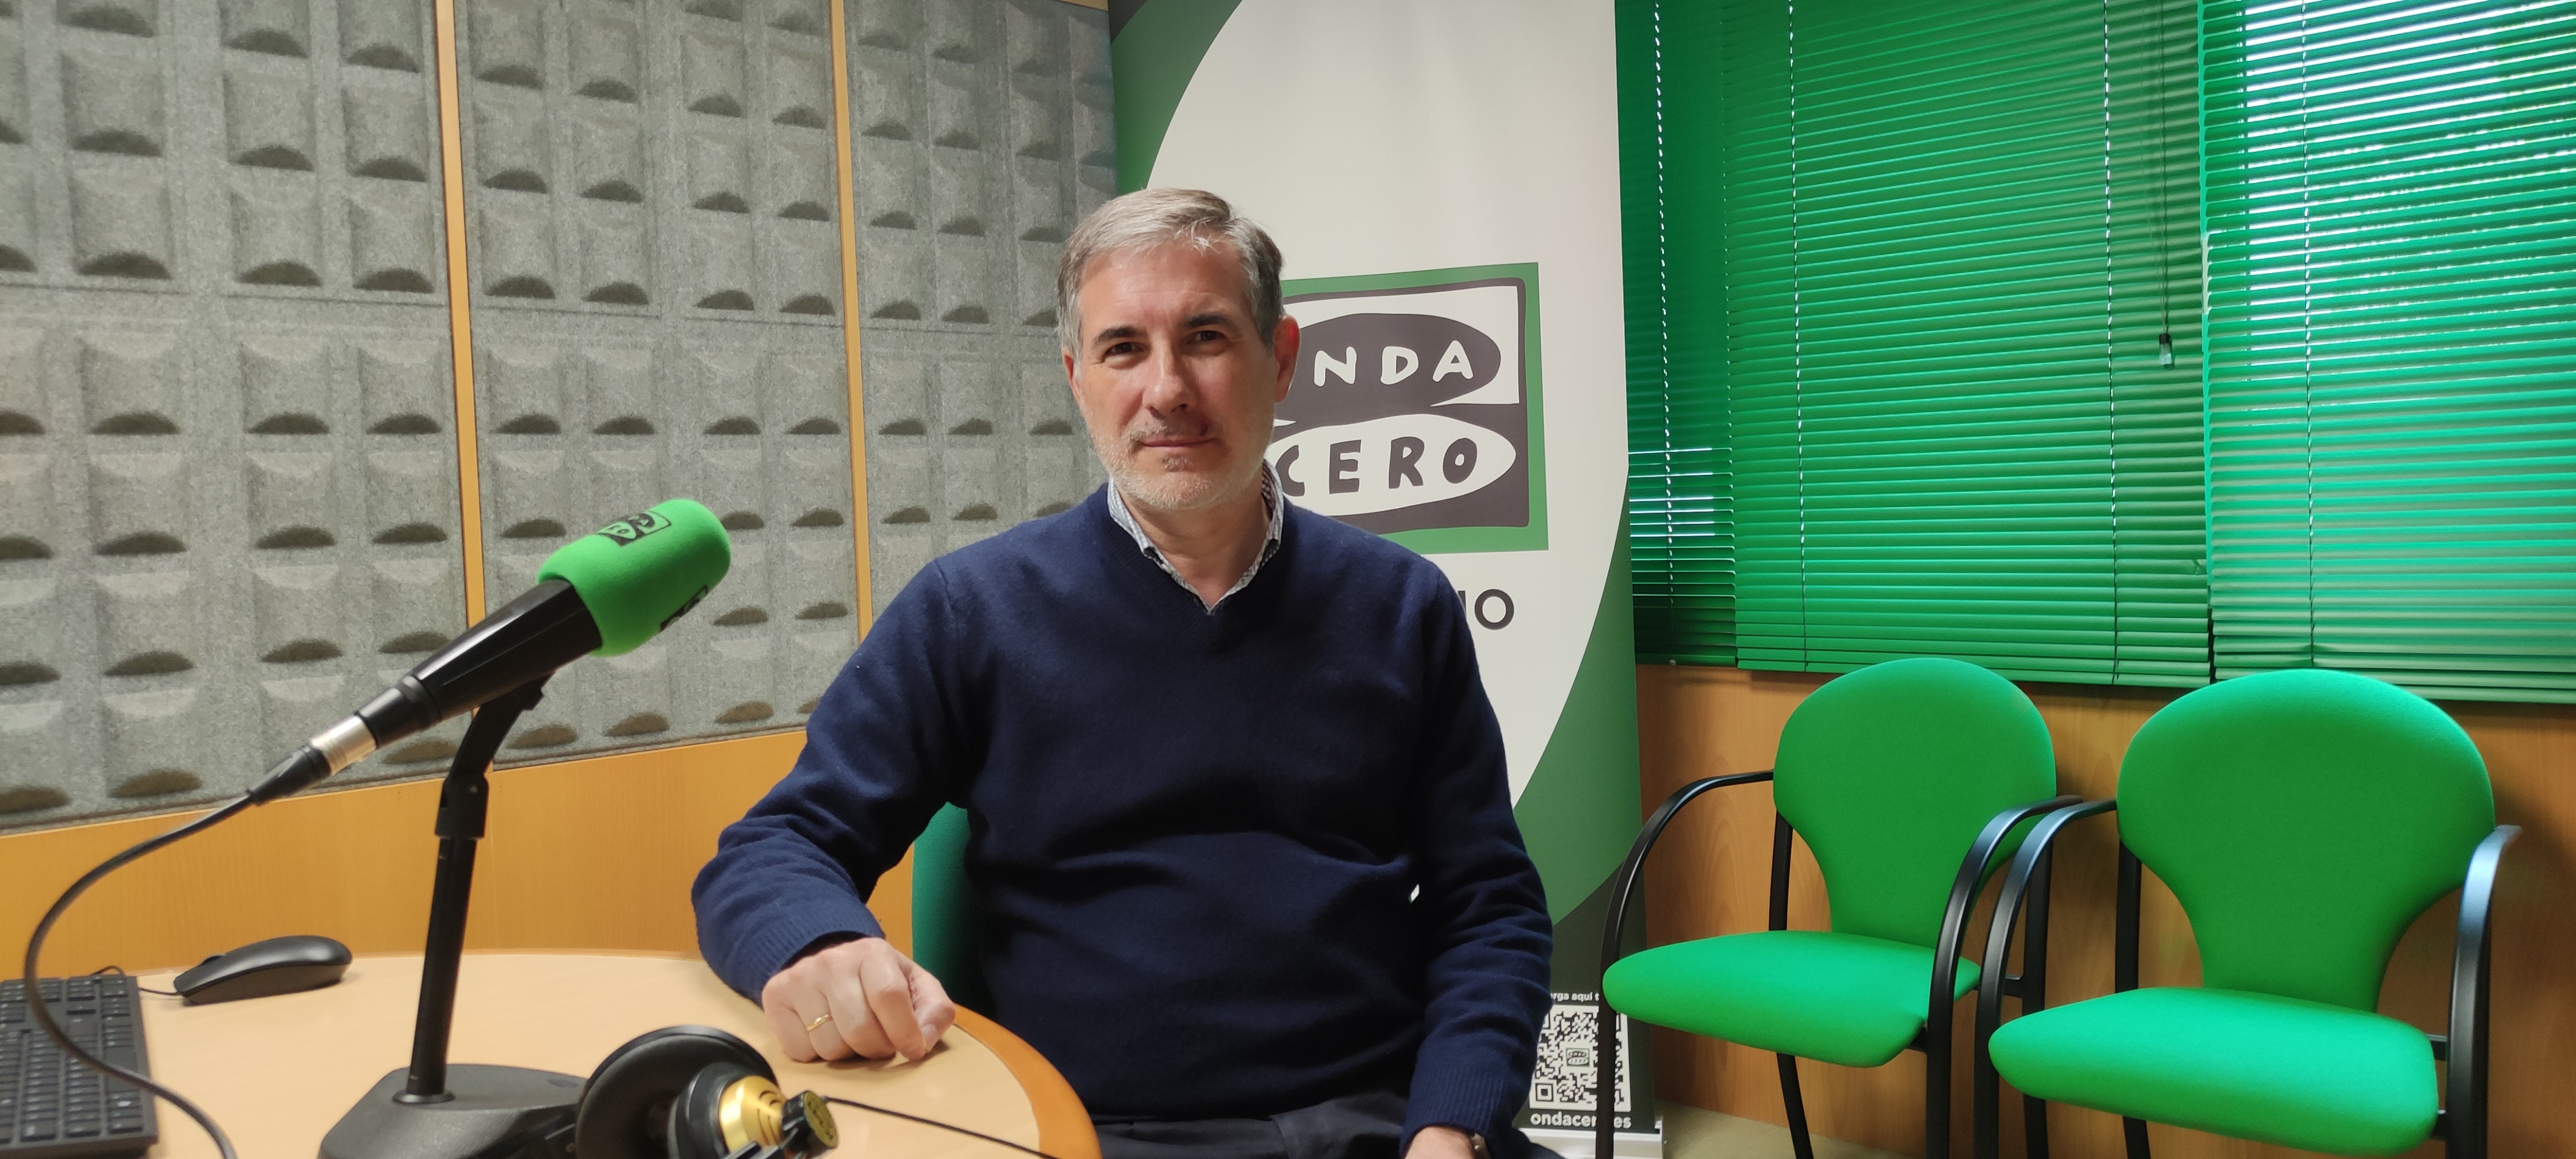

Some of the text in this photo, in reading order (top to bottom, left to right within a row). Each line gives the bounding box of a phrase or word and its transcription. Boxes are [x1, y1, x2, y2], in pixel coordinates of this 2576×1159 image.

[1314, 340, 1473, 386] NDA
[1275, 436, 1478, 497] CERO
[1571, 992, 1593, 1003] aquí
[1594, 992, 1600, 1001] t
[1529, 1111, 1631, 1129] ondaceres
